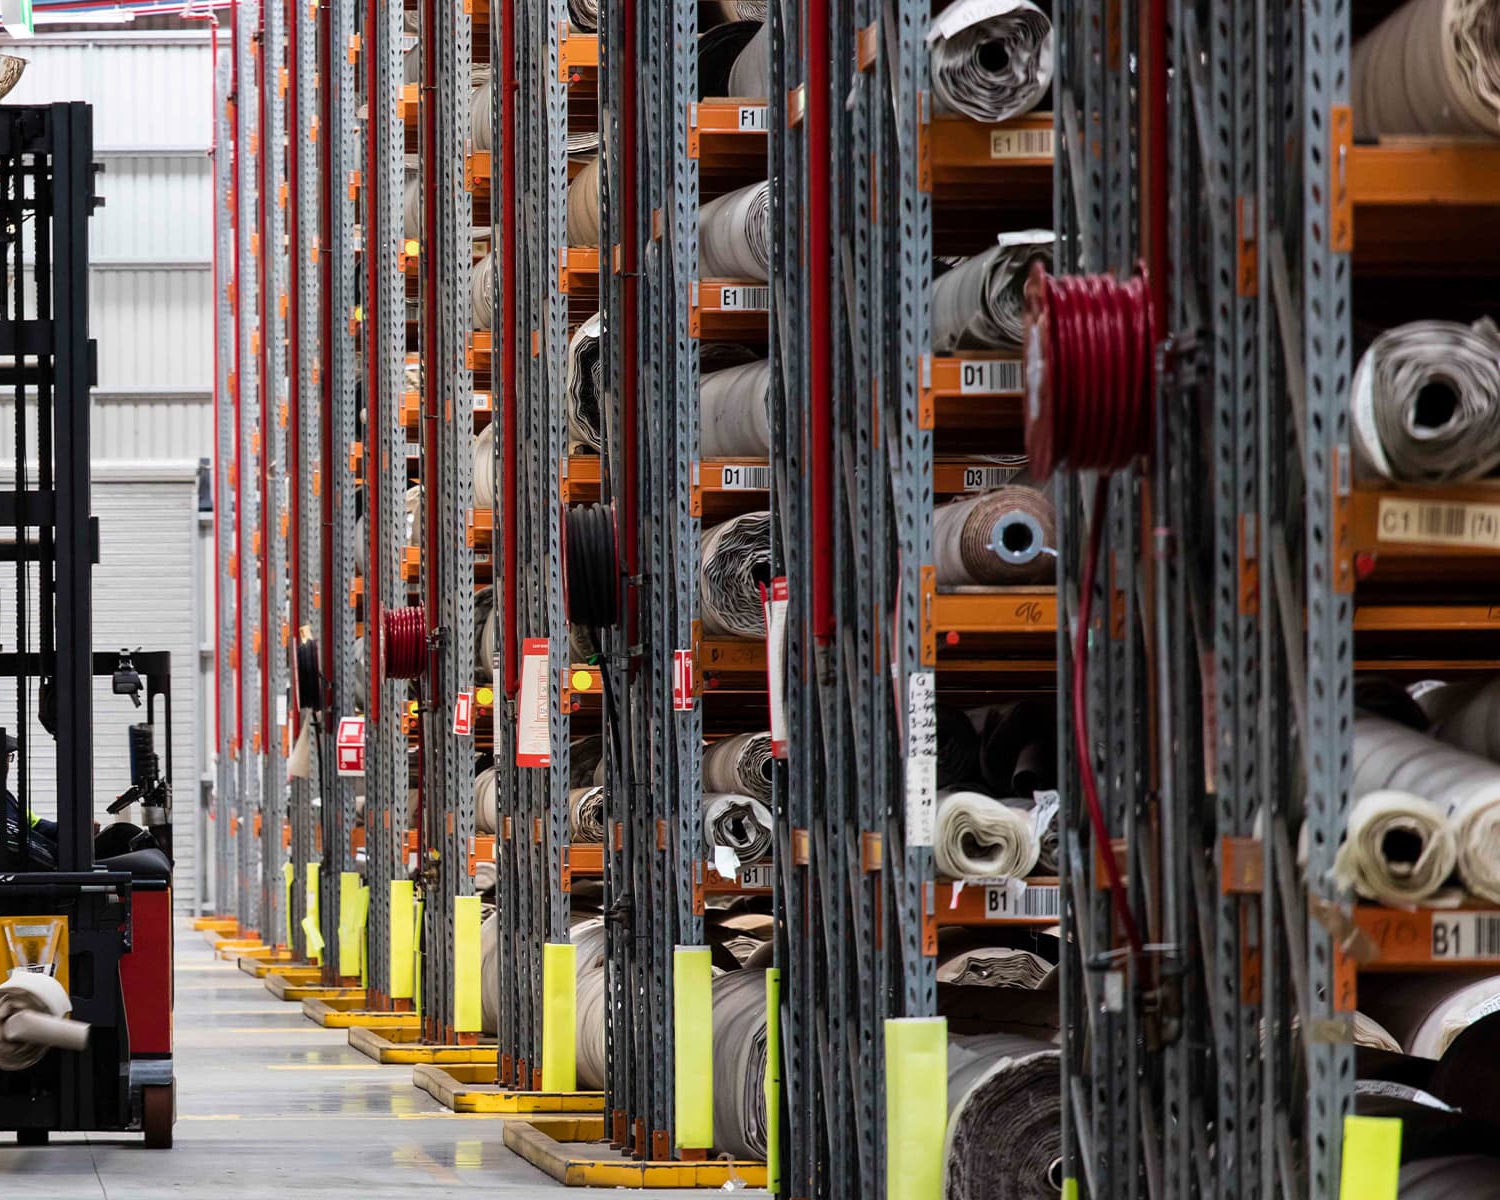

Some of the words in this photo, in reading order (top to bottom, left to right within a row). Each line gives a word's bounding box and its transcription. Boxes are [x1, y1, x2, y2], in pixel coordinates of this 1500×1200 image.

[741, 110, 755, 126] F1
[993, 137, 1011, 153] E1
[723, 290, 737, 306] E1
[964, 365, 983, 386] D1
[724, 468, 740, 485] D1
[966, 470, 983, 487] D3
[1471, 515, 1497, 540] (74)
[744, 867, 758, 883] B1
[989, 891, 1008, 912] B1
[1433, 921, 1460, 955] B1
